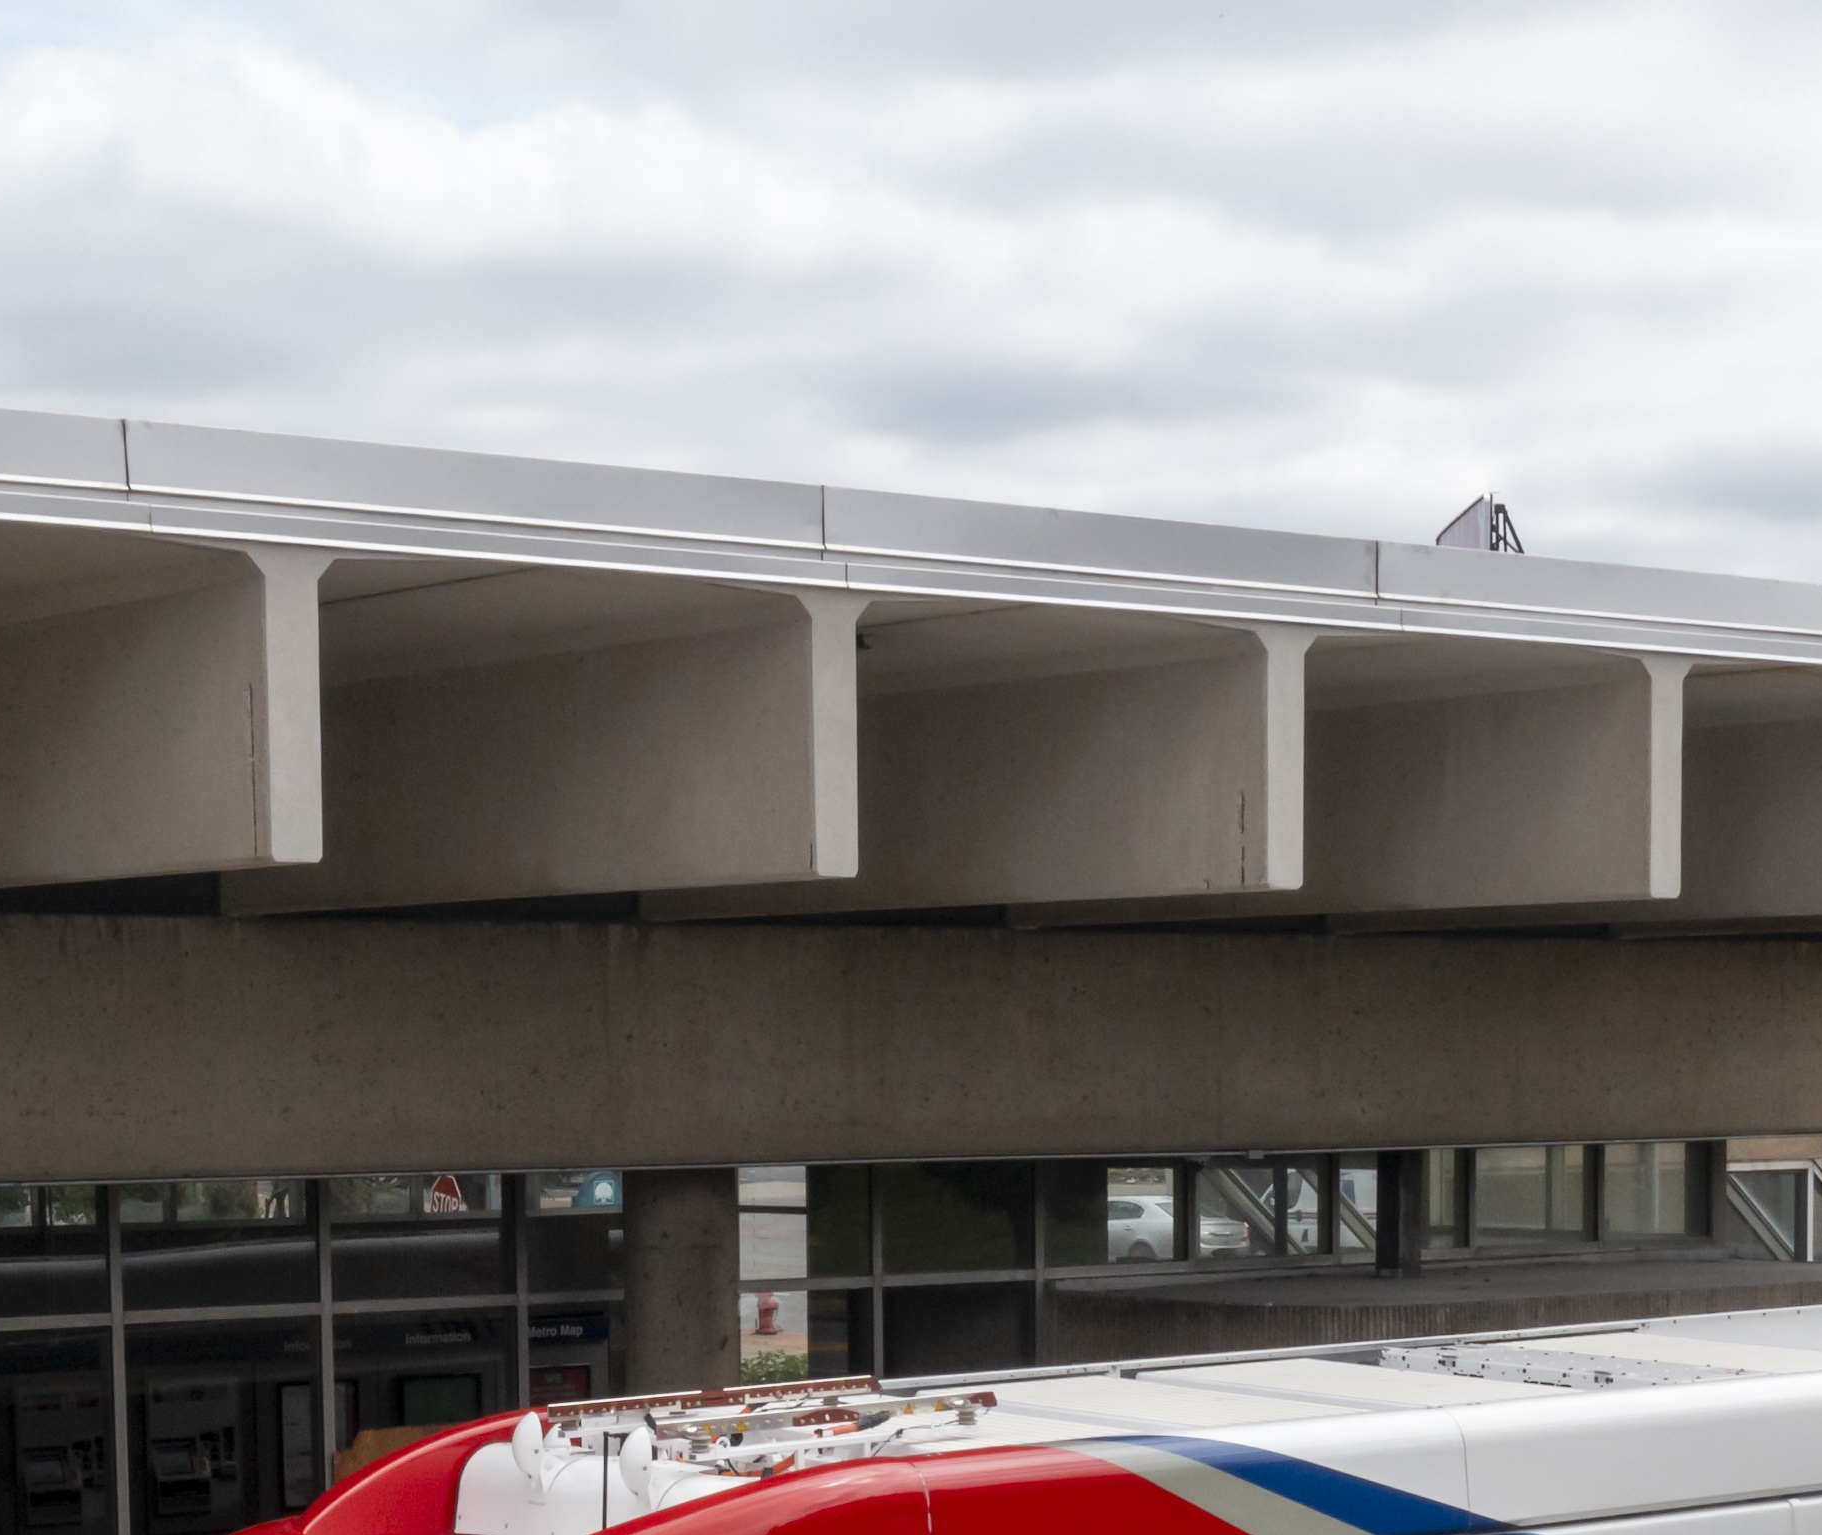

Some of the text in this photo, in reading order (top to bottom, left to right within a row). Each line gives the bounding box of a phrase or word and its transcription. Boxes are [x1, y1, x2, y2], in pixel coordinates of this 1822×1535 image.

[432, 1191, 460, 1212] STOP
[405, 1331, 471, 1346] Information
[529, 1325, 584, 1338] Metro Map
